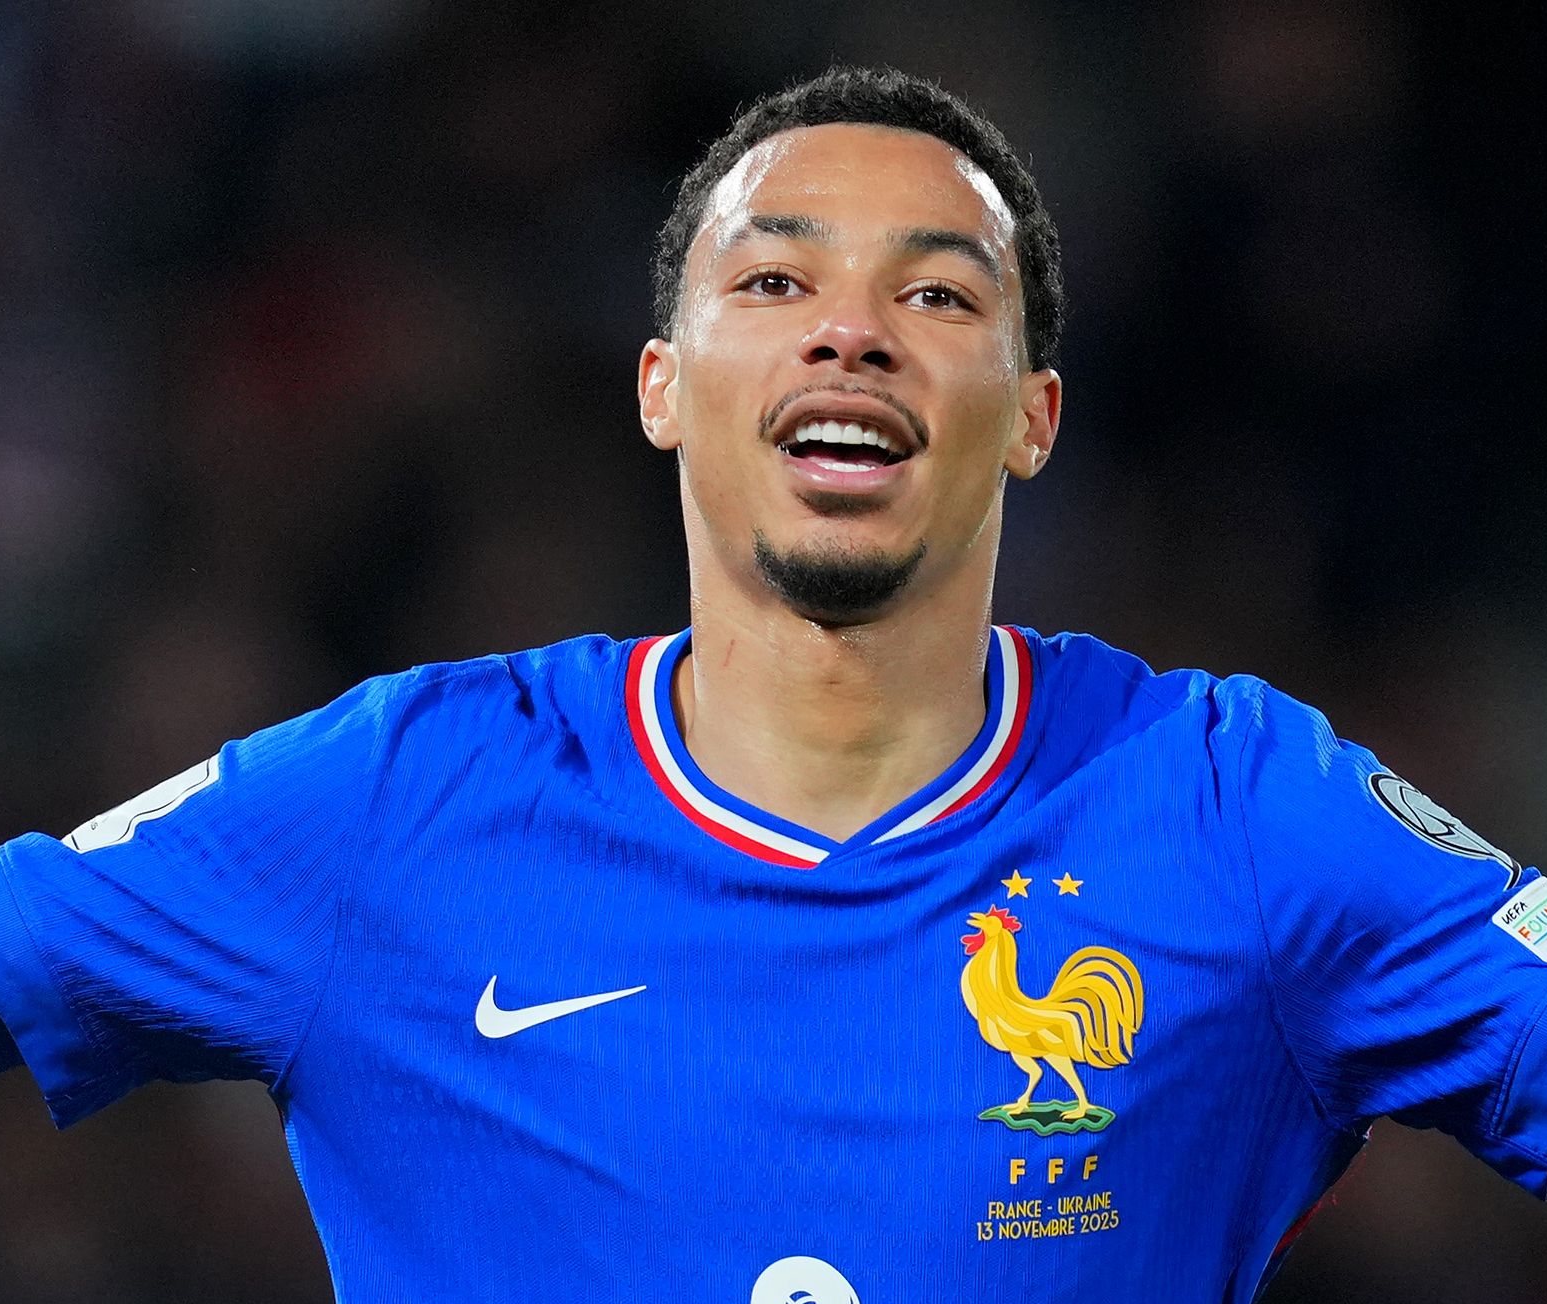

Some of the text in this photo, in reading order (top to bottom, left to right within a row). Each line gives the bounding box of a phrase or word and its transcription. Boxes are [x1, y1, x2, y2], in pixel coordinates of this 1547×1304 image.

[1501, 901, 1528, 925] UEFA
[987, 1200, 1042, 1220] FRANCE
[1057, 1191, 1112, 1216] UKRAINE
[976, 1210, 1120, 1241] 13 NOVEMBRE 2025
